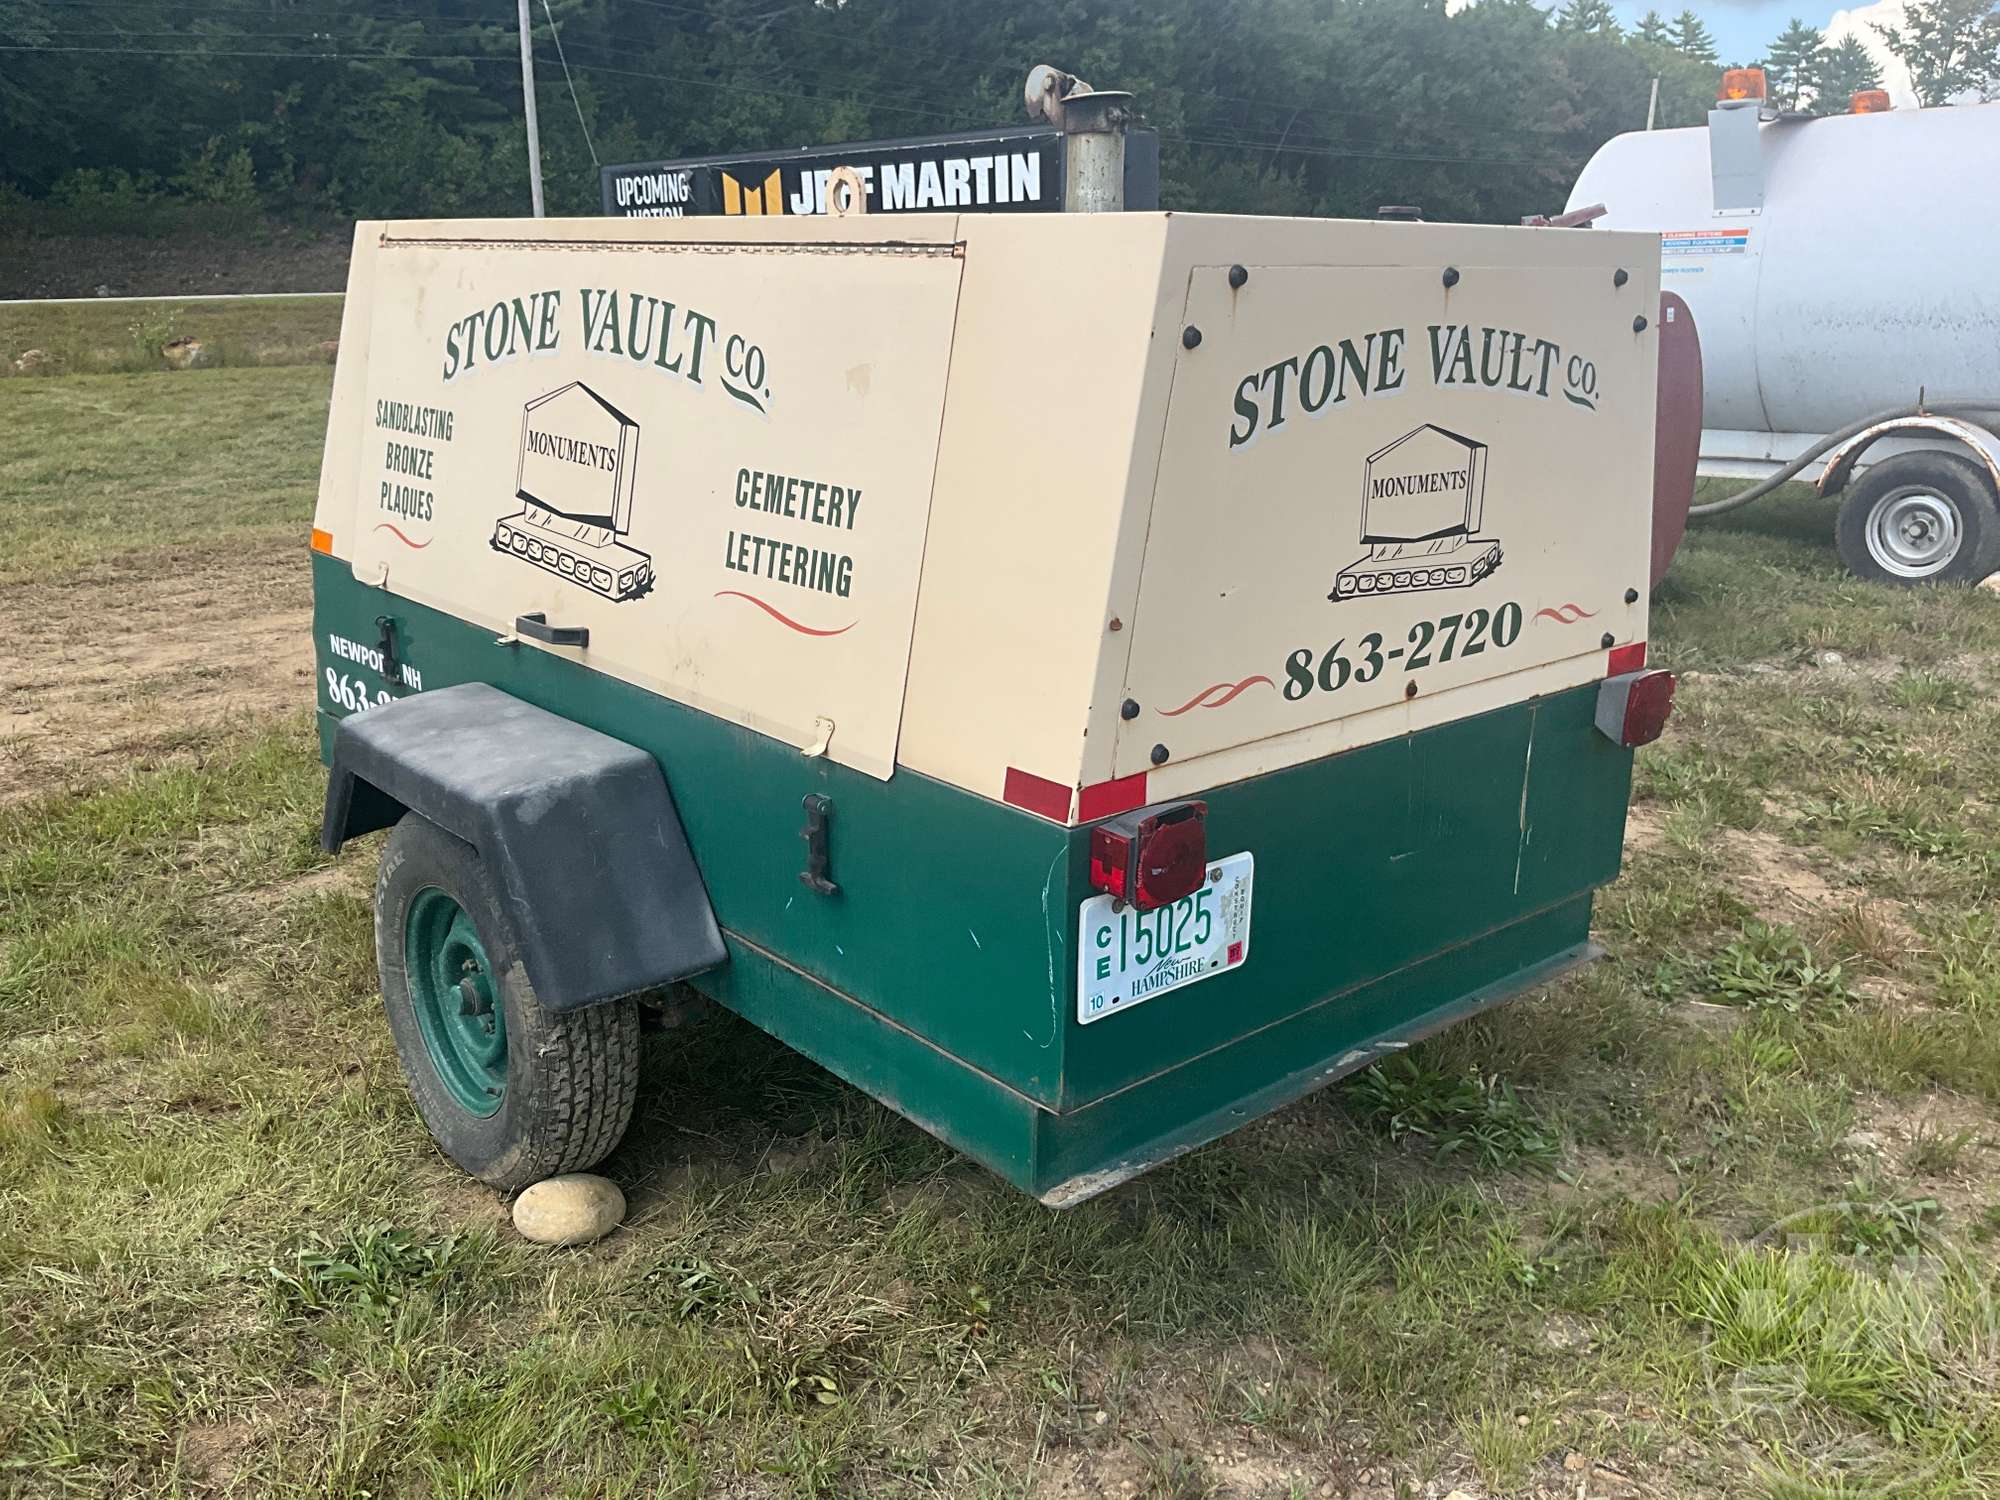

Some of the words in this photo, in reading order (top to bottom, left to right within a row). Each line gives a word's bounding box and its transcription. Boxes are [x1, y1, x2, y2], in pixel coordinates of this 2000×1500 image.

[616, 173, 688, 206] UPCOMING
[881, 152, 1041, 210] MARTIN
[443, 290, 560, 382] STONE
[580, 289, 716, 384] VAULT
[725, 334, 771, 400] CO.
[1230, 329, 1405, 448] STONE
[1427, 325, 1560, 397] VAULT
[1567, 355, 1600, 400] CO.
[375, 398, 453, 442] SANDBLASTING
[386, 441, 433, 480] BRONZE
[527, 430, 616, 472] MONUMENTS
[380, 481, 433, 522] PLAQUES
[735, 467, 862, 531] CEMETERY
[1371, 470, 1467, 500] MONUMENTS
[725, 531, 853, 598] LETTERING
[1283, 601, 1523, 702] 863-2720
[402, 663, 422, 692] NH
[1119, 887, 1213, 972] 15025
[1132, 956, 1206, 997] HAMPSHIRE
[1090, 994, 1105, 1011] 10
